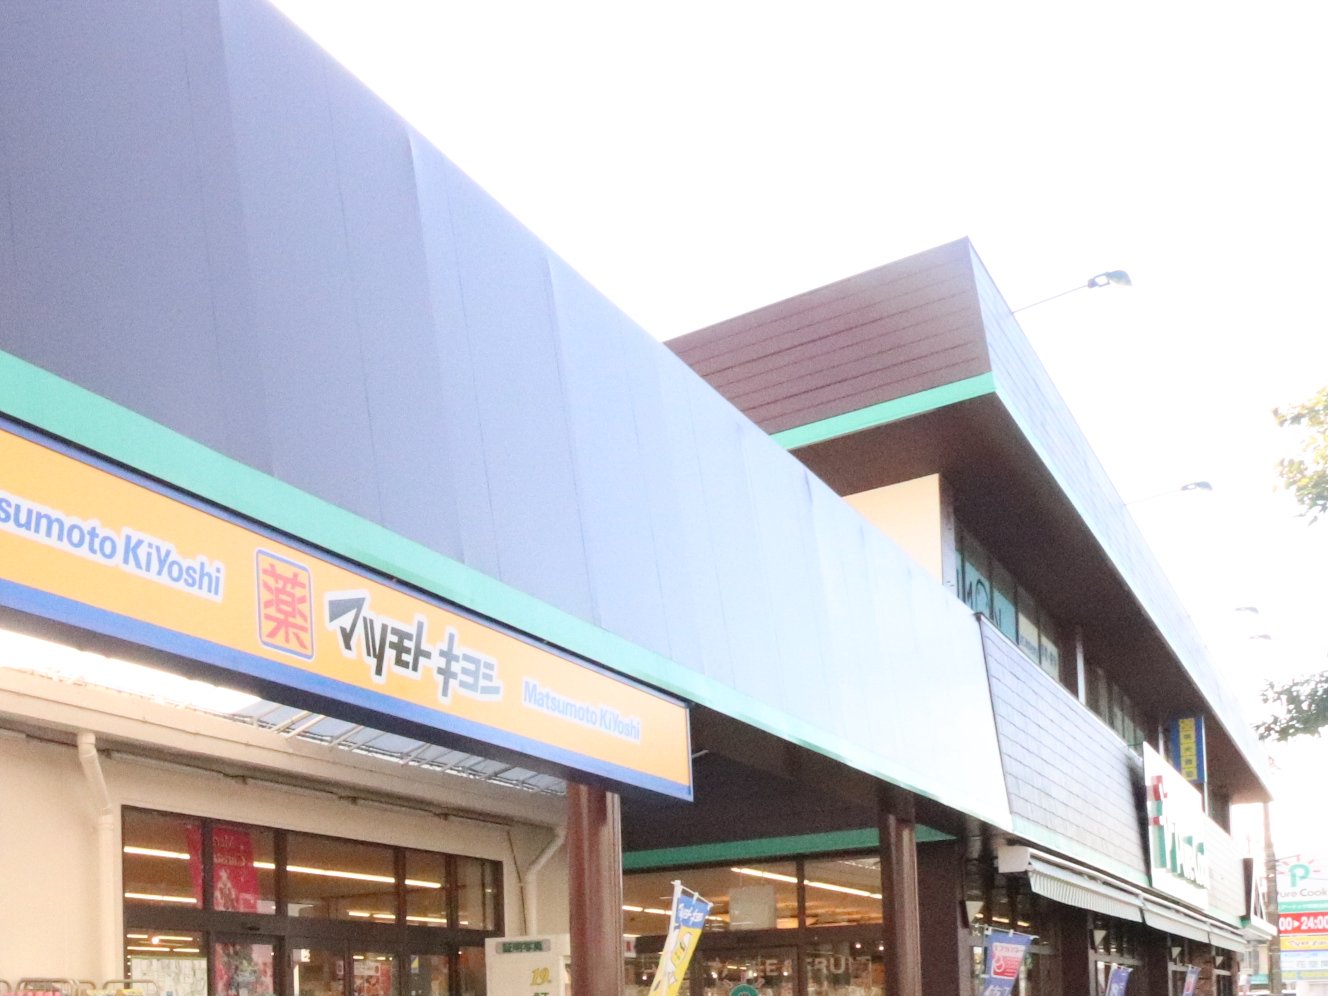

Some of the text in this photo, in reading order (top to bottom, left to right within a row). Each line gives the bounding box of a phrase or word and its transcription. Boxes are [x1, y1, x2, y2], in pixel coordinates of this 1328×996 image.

[122, 533, 222, 596] KiYoshi
[262, 562, 309, 652] 薬
[328, 595, 502, 699] マツモトキヨシ
[523, 680, 641, 740] Matsumoto KiYoshi
[1276, 890, 1298, 898] ure
